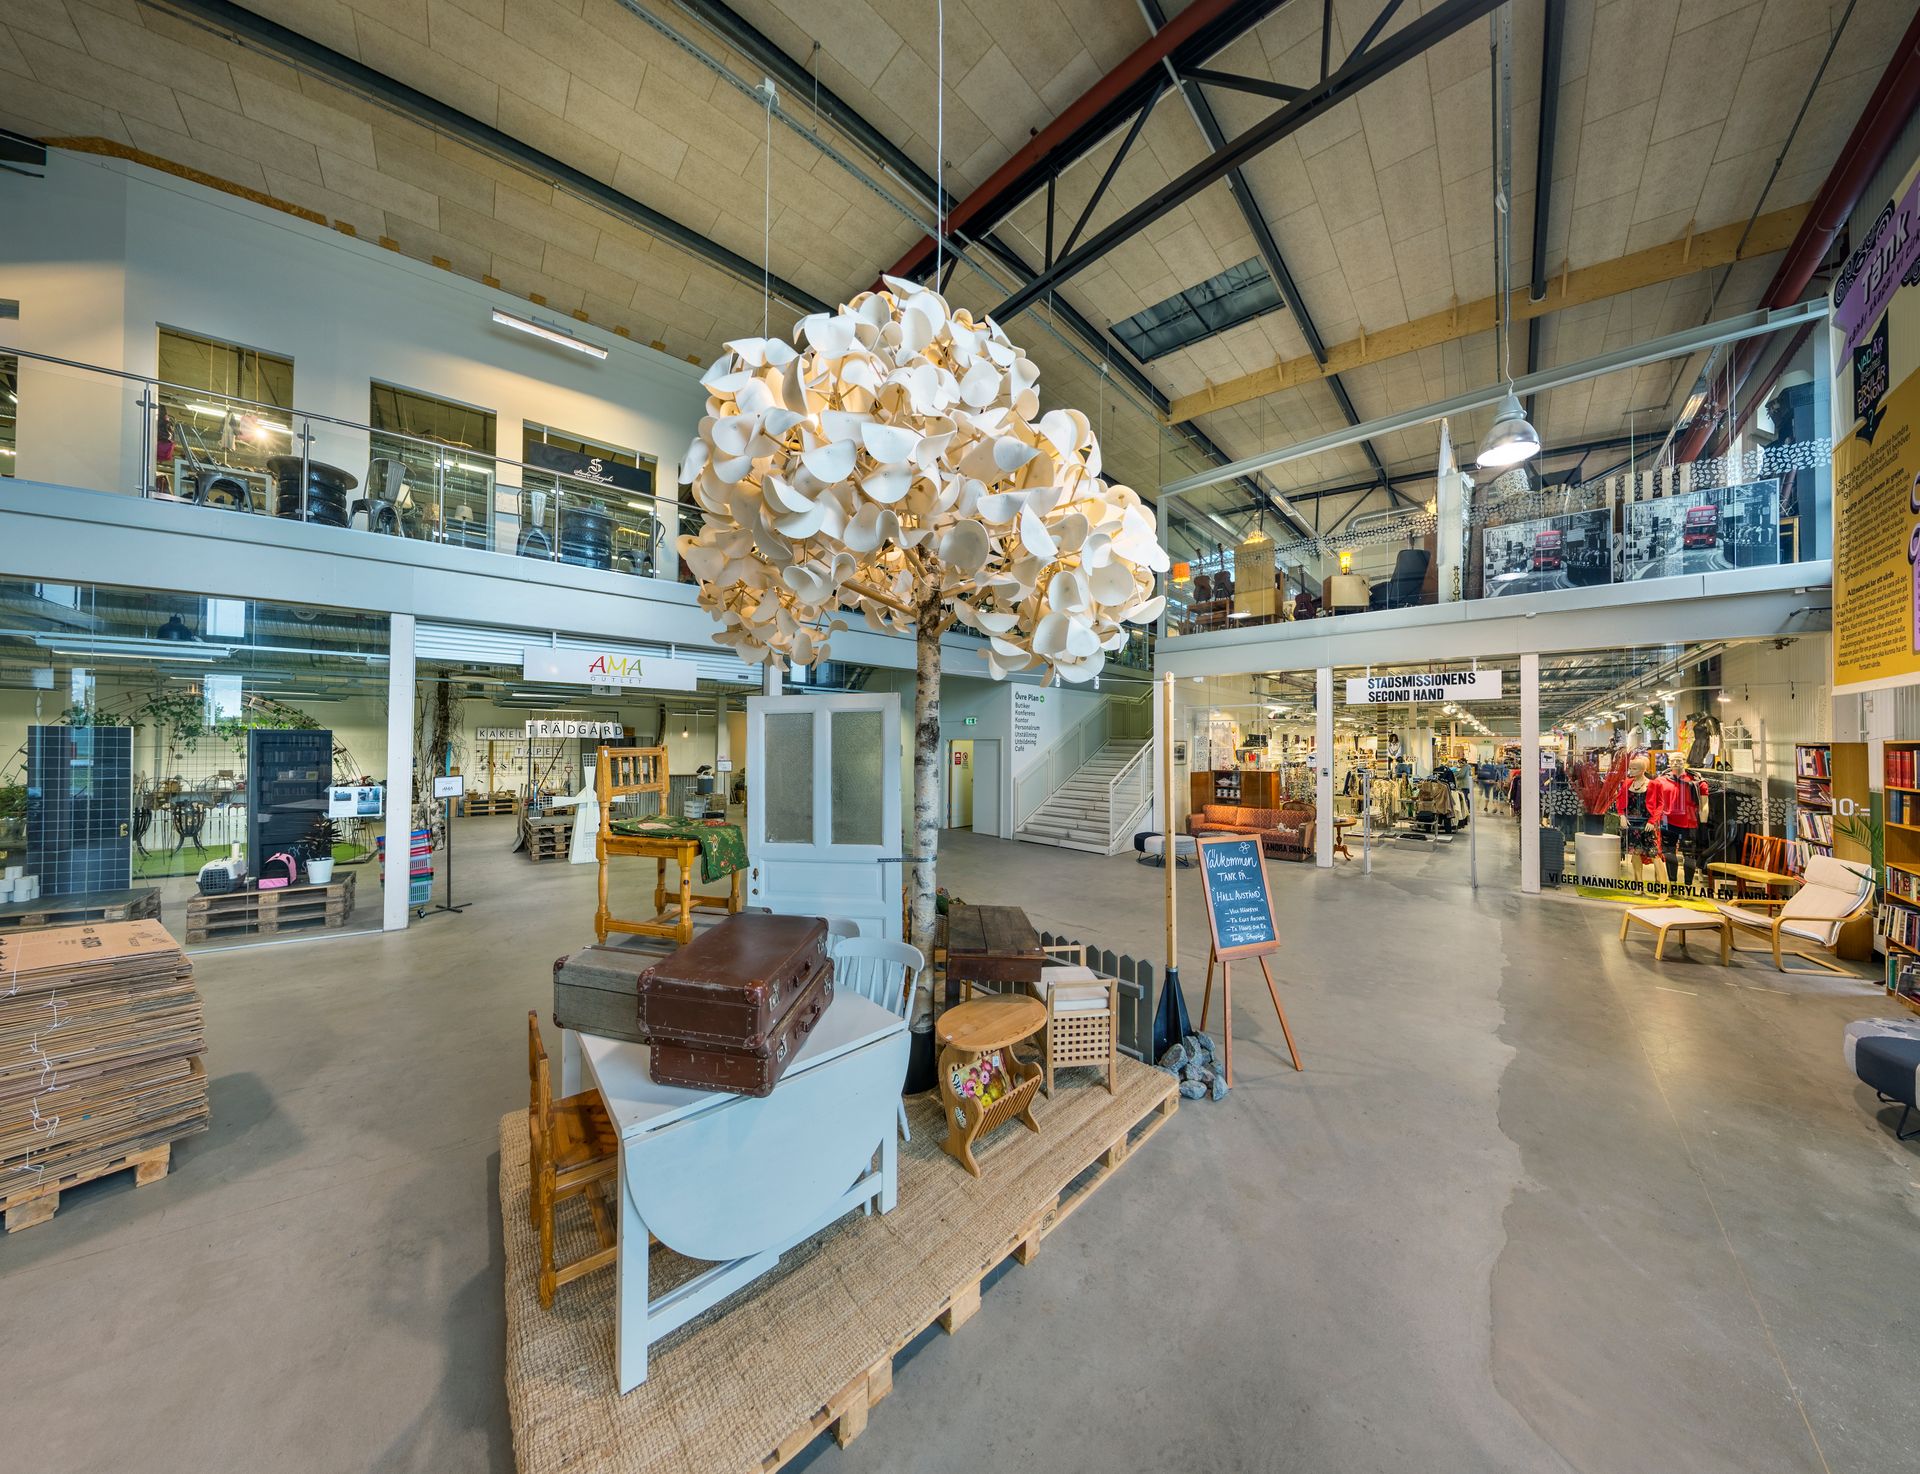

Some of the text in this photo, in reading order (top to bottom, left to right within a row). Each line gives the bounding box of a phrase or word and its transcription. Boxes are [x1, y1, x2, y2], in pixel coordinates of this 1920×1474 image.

[1861, 210, 1910, 305] Tänk
[1873, 336, 1884, 355] ÄR
[589, 655, 643, 676] AMA
[590, 677, 642, 685] OUTLET
[1367, 672, 1476, 689] STADSMISSIONENS
[1015, 691, 1027, 700] Övre
[1368, 688, 1444, 702] SECOND HAND
[479, 730, 523, 739] KAKEL
[527, 722, 623, 736] TRÄDGÅRD
[1015, 731, 1038, 739] Utställning
[516, 746, 561, 755] TAPET
[1266, 842, 1287, 853] ANDRA
[1204, 849, 1258, 869] Välkommen
[1549, 873, 1558, 883] VI
[1561, 874, 1579, 885] GER
[1582, 875, 1644, 892] MÄNNISKOR
[1647, 882, 1667, 894] OCH
[1671, 884, 1714, 899] PRYLAR
[1718, 889, 1733, 900] EN
